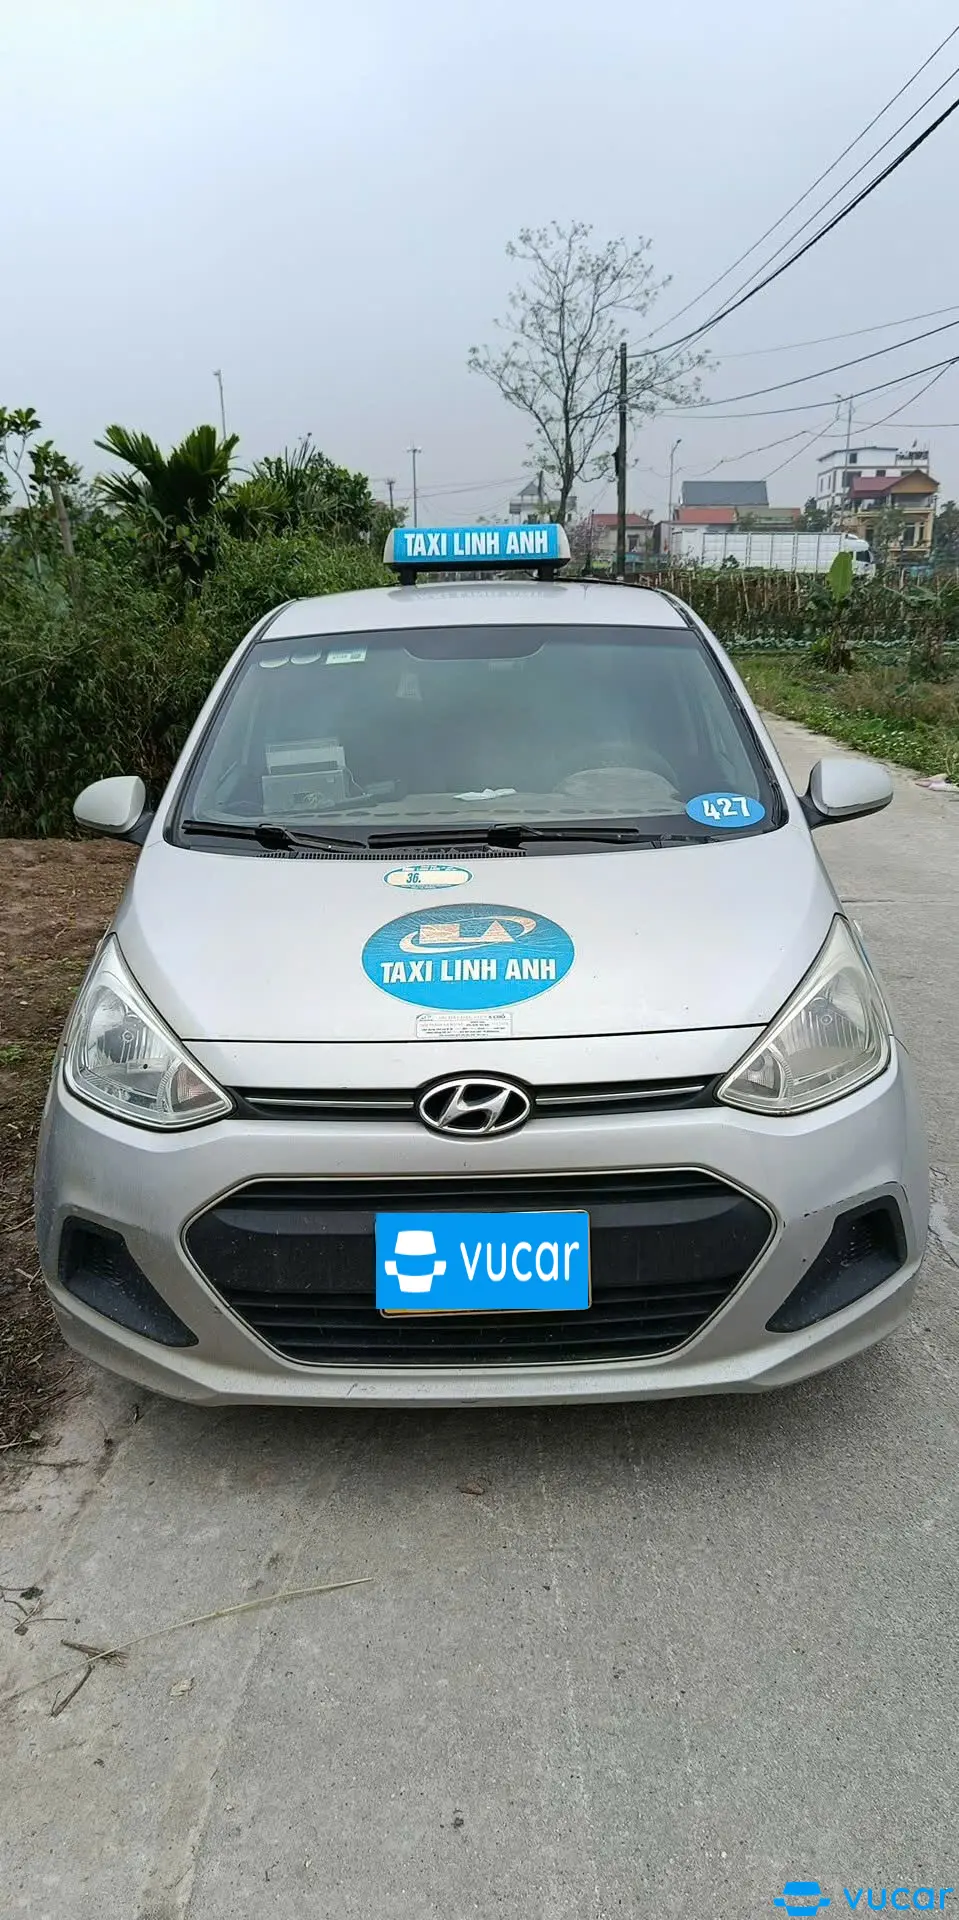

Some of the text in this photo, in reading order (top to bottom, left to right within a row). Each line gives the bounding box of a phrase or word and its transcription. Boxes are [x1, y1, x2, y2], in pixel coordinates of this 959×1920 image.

[404, 530, 548, 557] TAXI LINH ANH
[702, 796, 750, 820] 427
[380, 958, 556, 984] TAXI LINH ANH
